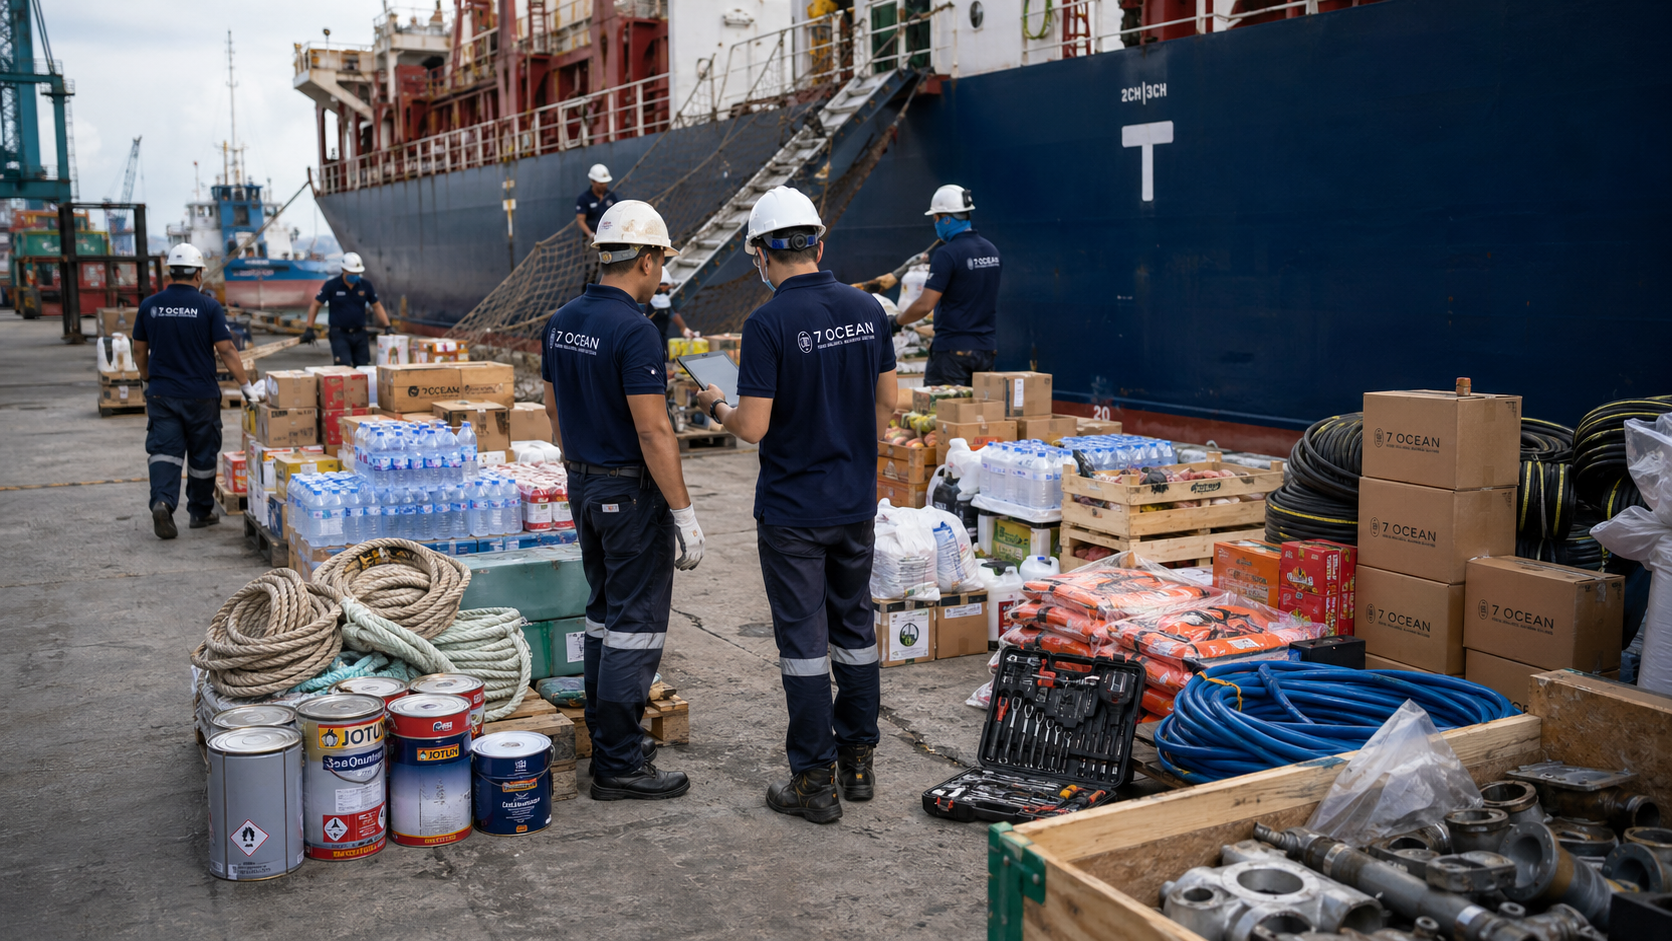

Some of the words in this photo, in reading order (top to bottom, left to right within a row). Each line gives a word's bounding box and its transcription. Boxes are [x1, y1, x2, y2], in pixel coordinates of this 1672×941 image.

[1122, 120, 1174, 202] T
[158, 306, 164, 314] 7
[165, 306, 198, 315] OCEAN
[556, 330, 563, 342] 7
[564, 332, 600, 350] OCEAN
[813, 330, 822, 343] 7
[825, 321, 875, 341] OCEAN
[1093, 404, 1110, 422] 20
[1386, 431, 1393, 442] 7
[1396, 433, 1440, 448] OCEAN
[1382, 521, 1389, 533] 7
[1392, 523, 1436, 542] OCEAN
[1378, 608, 1385, 619] 7
[1387, 611, 1431, 632] OCEAN
[1492, 604, 1499, 616] 7
[1503, 607, 1554, 630] OCEAN
